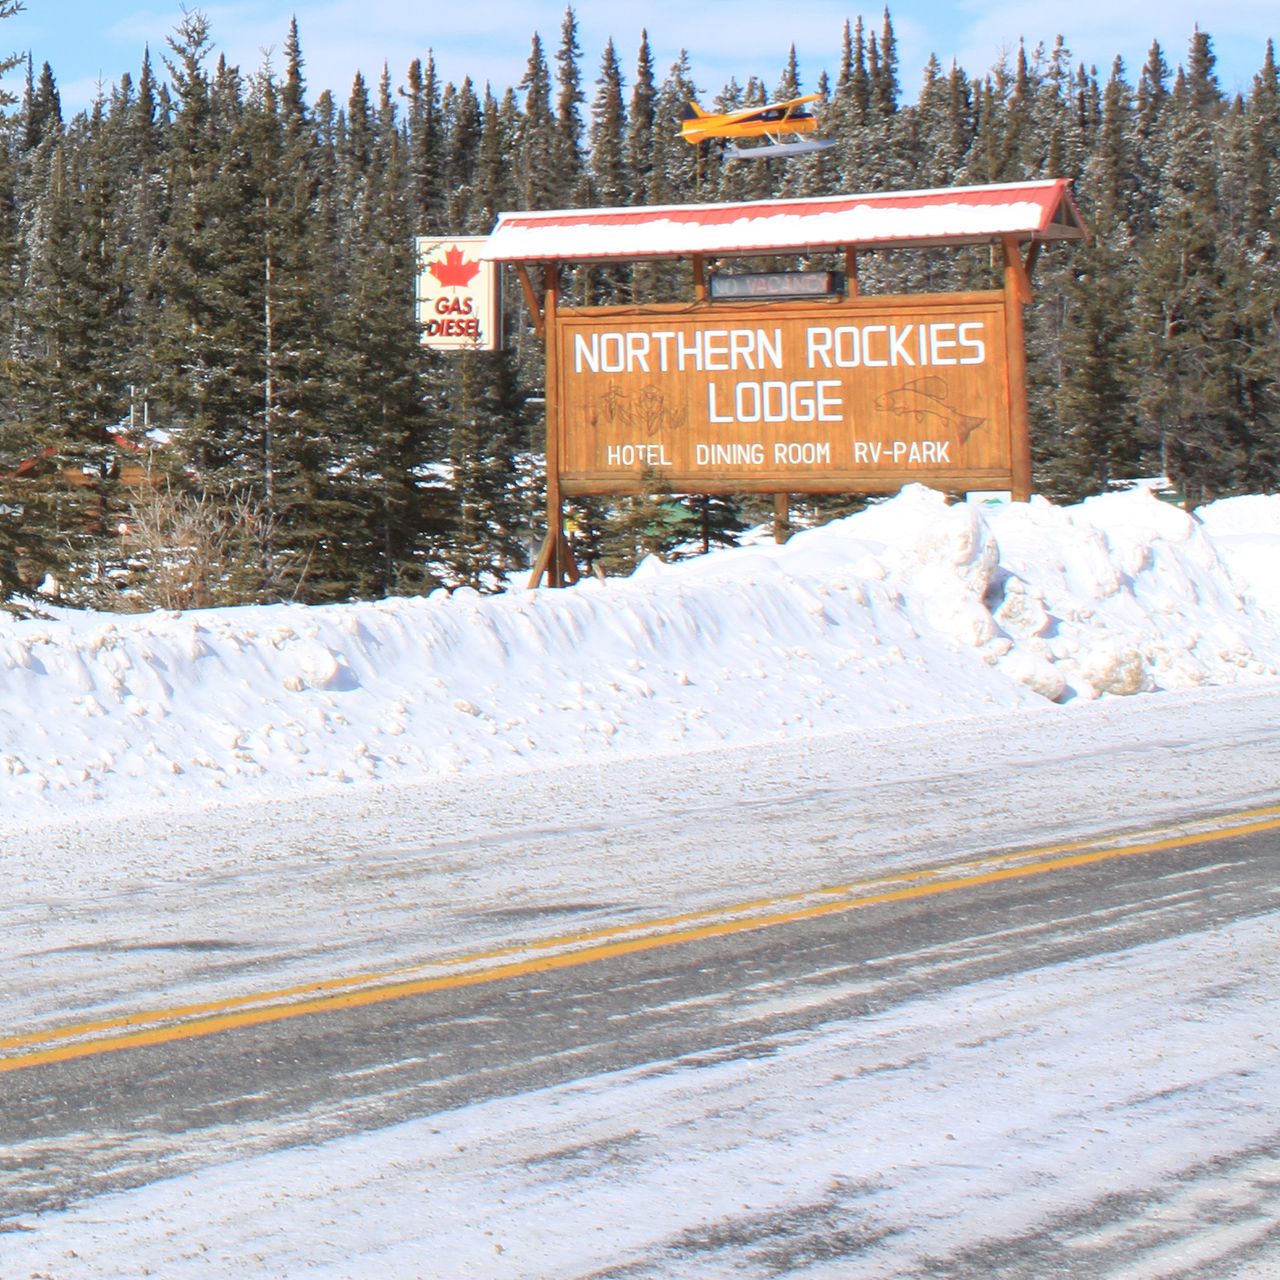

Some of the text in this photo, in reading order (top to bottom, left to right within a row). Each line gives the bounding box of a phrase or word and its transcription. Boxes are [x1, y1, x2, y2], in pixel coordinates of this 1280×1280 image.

[435, 296, 473, 315] GAS
[427, 318, 482, 337] DIESEL
[574, 322, 986, 372] NORTHERN ROCKIES
[708, 380, 843, 422] LODGE
[607, 441, 950, 466] HOTEL DINING ROOM RV-PARK
